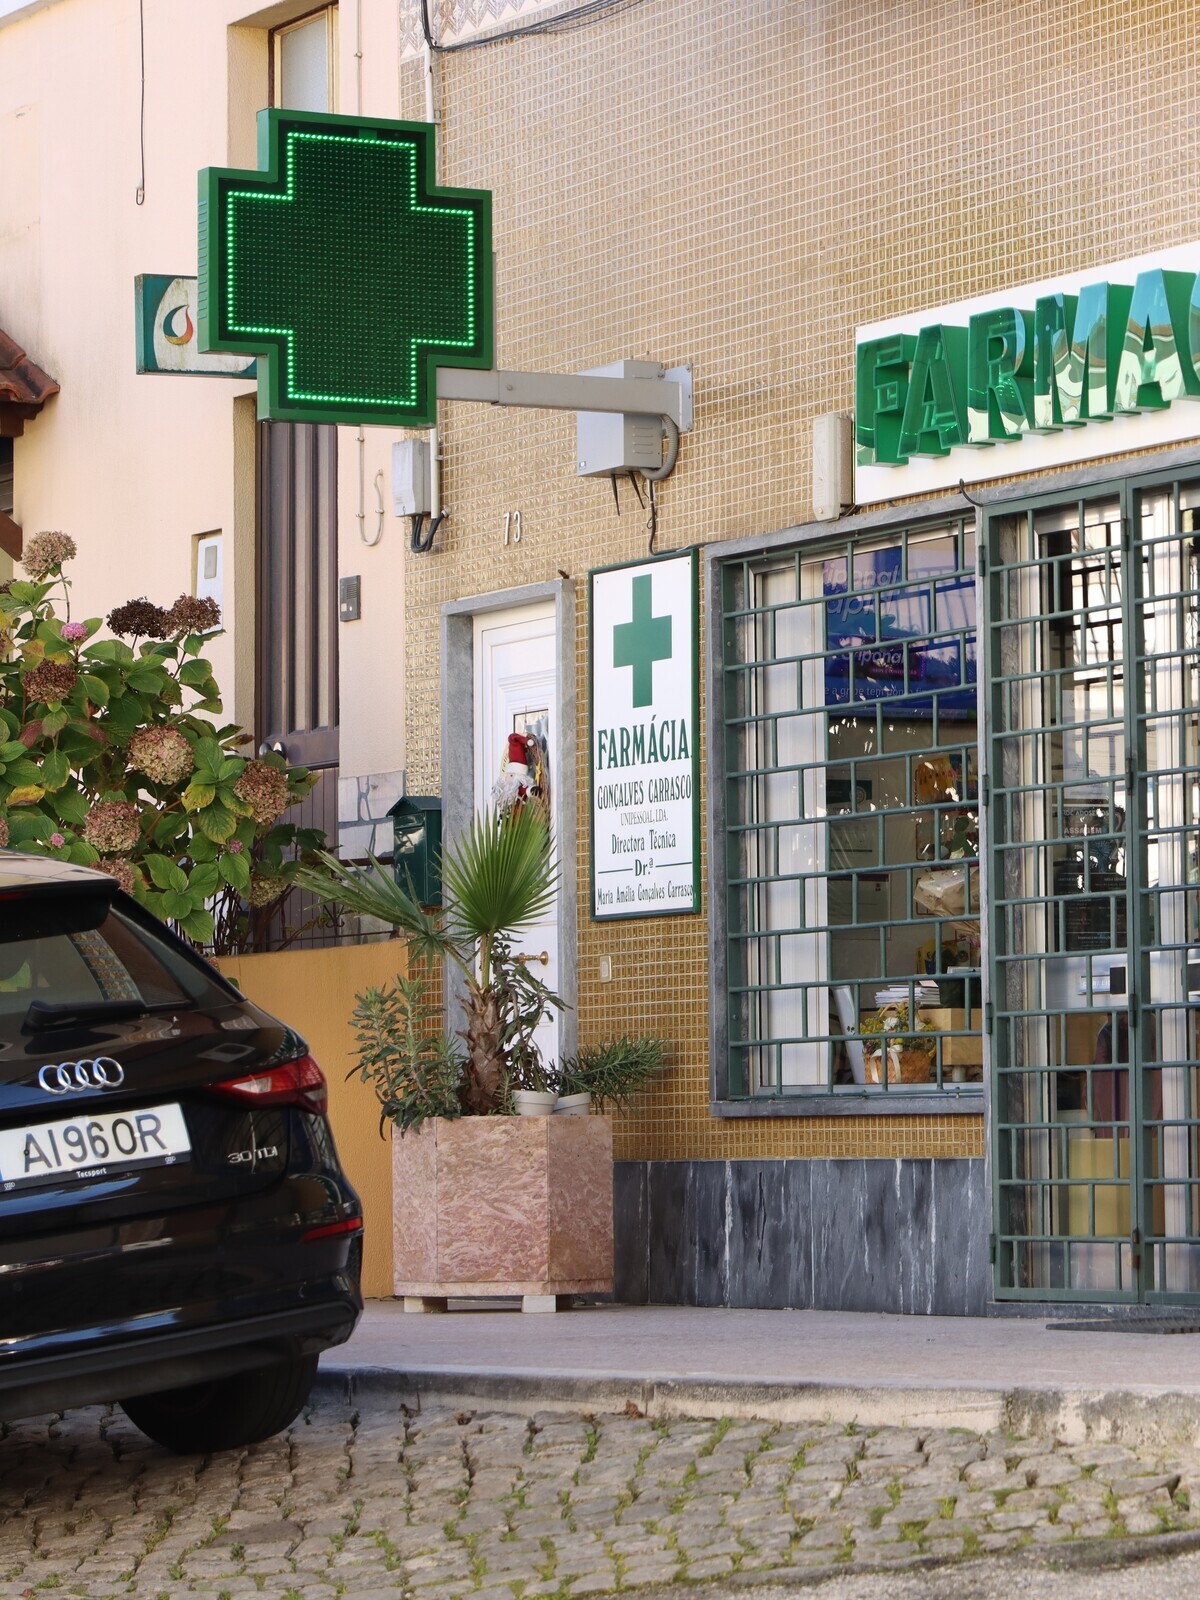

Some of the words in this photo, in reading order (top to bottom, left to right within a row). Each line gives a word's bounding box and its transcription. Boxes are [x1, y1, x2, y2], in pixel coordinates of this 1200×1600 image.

[597, 714, 690, 771] FARMÁCIA
[597, 780, 645, 812] GONÇALVES
[648, 774, 692, 804] CARRASCO
[611, 834, 645, 855] Directora
[649, 829, 677, 851] Técnica
[616, 885, 636, 904] Amélia
[637, 882, 666, 903] Gonçalves
[667, 880, 693, 899] Carrasco
[76, 1167, 107, 1179] Tecsport
